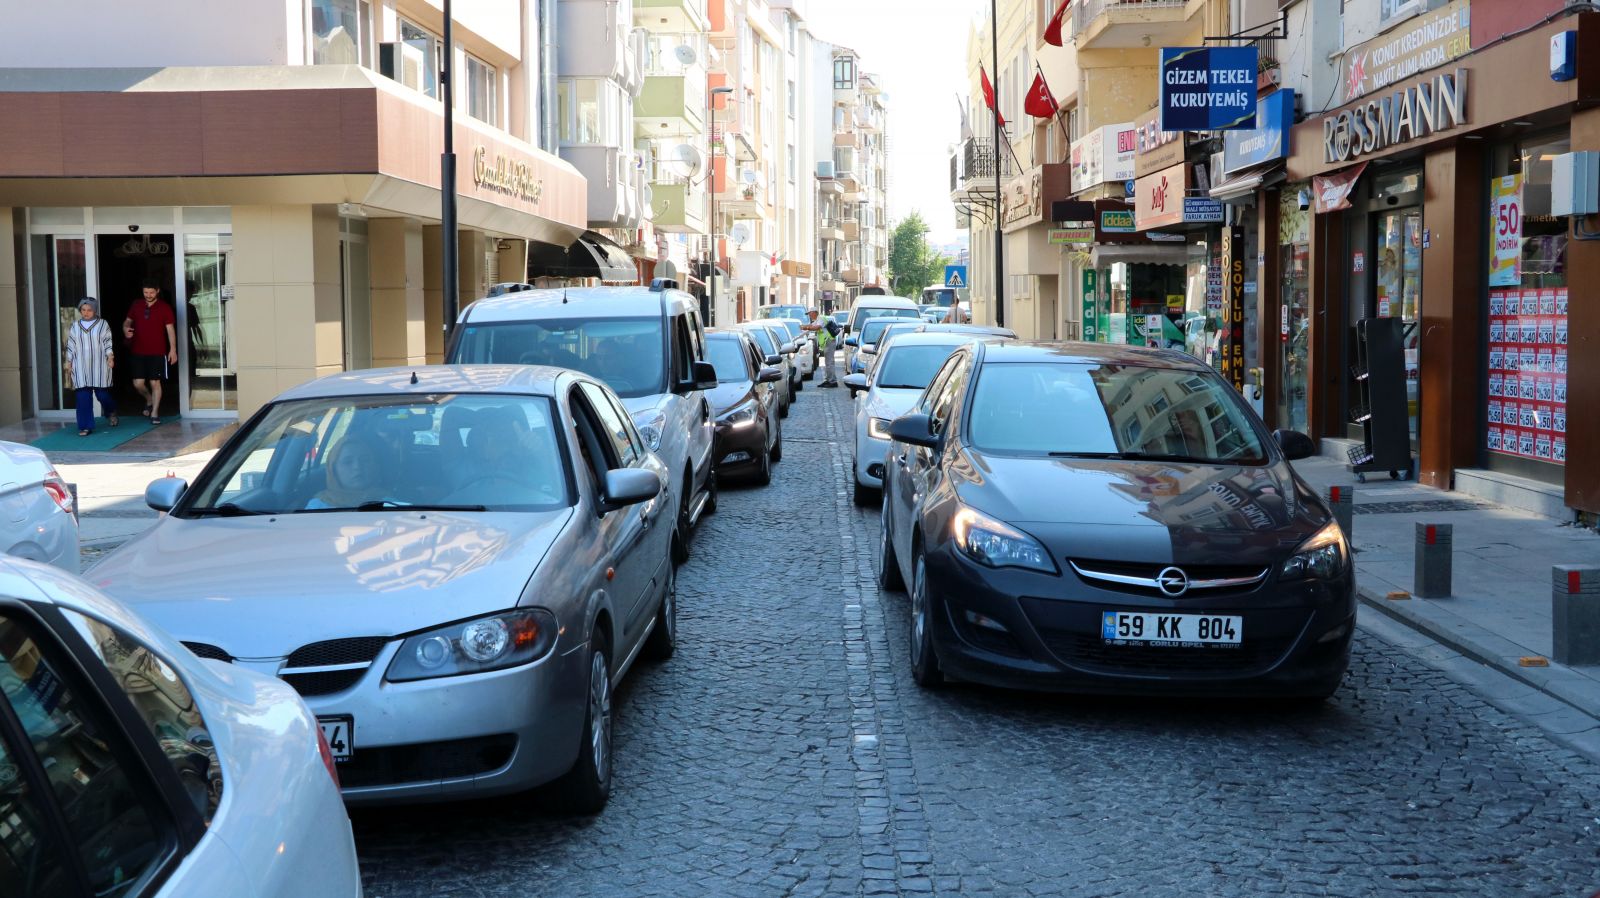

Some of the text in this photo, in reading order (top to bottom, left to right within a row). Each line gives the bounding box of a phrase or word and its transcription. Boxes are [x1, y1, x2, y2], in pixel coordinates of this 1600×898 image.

[1372, 41, 1400, 67] KONUT
[1401, 13, 1457, 54] KREDİNİZDE
[1166, 67, 1253, 84] GİZEM TEKEL
[1372, 62, 1396, 89] NAKİT
[1396, 46, 1445, 79] ALIMLARDA
[1170, 89, 1248, 110] KURUYEMİŞ
[1323, 67, 1468, 163] ROSSMANN
[1104, 213, 1132, 226] iddaa
[1222, 236, 1230, 323] SOYLU
[1233, 260, 1243, 322] SOYLU
[1106, 615, 1236, 640] TR 59 KK 804
